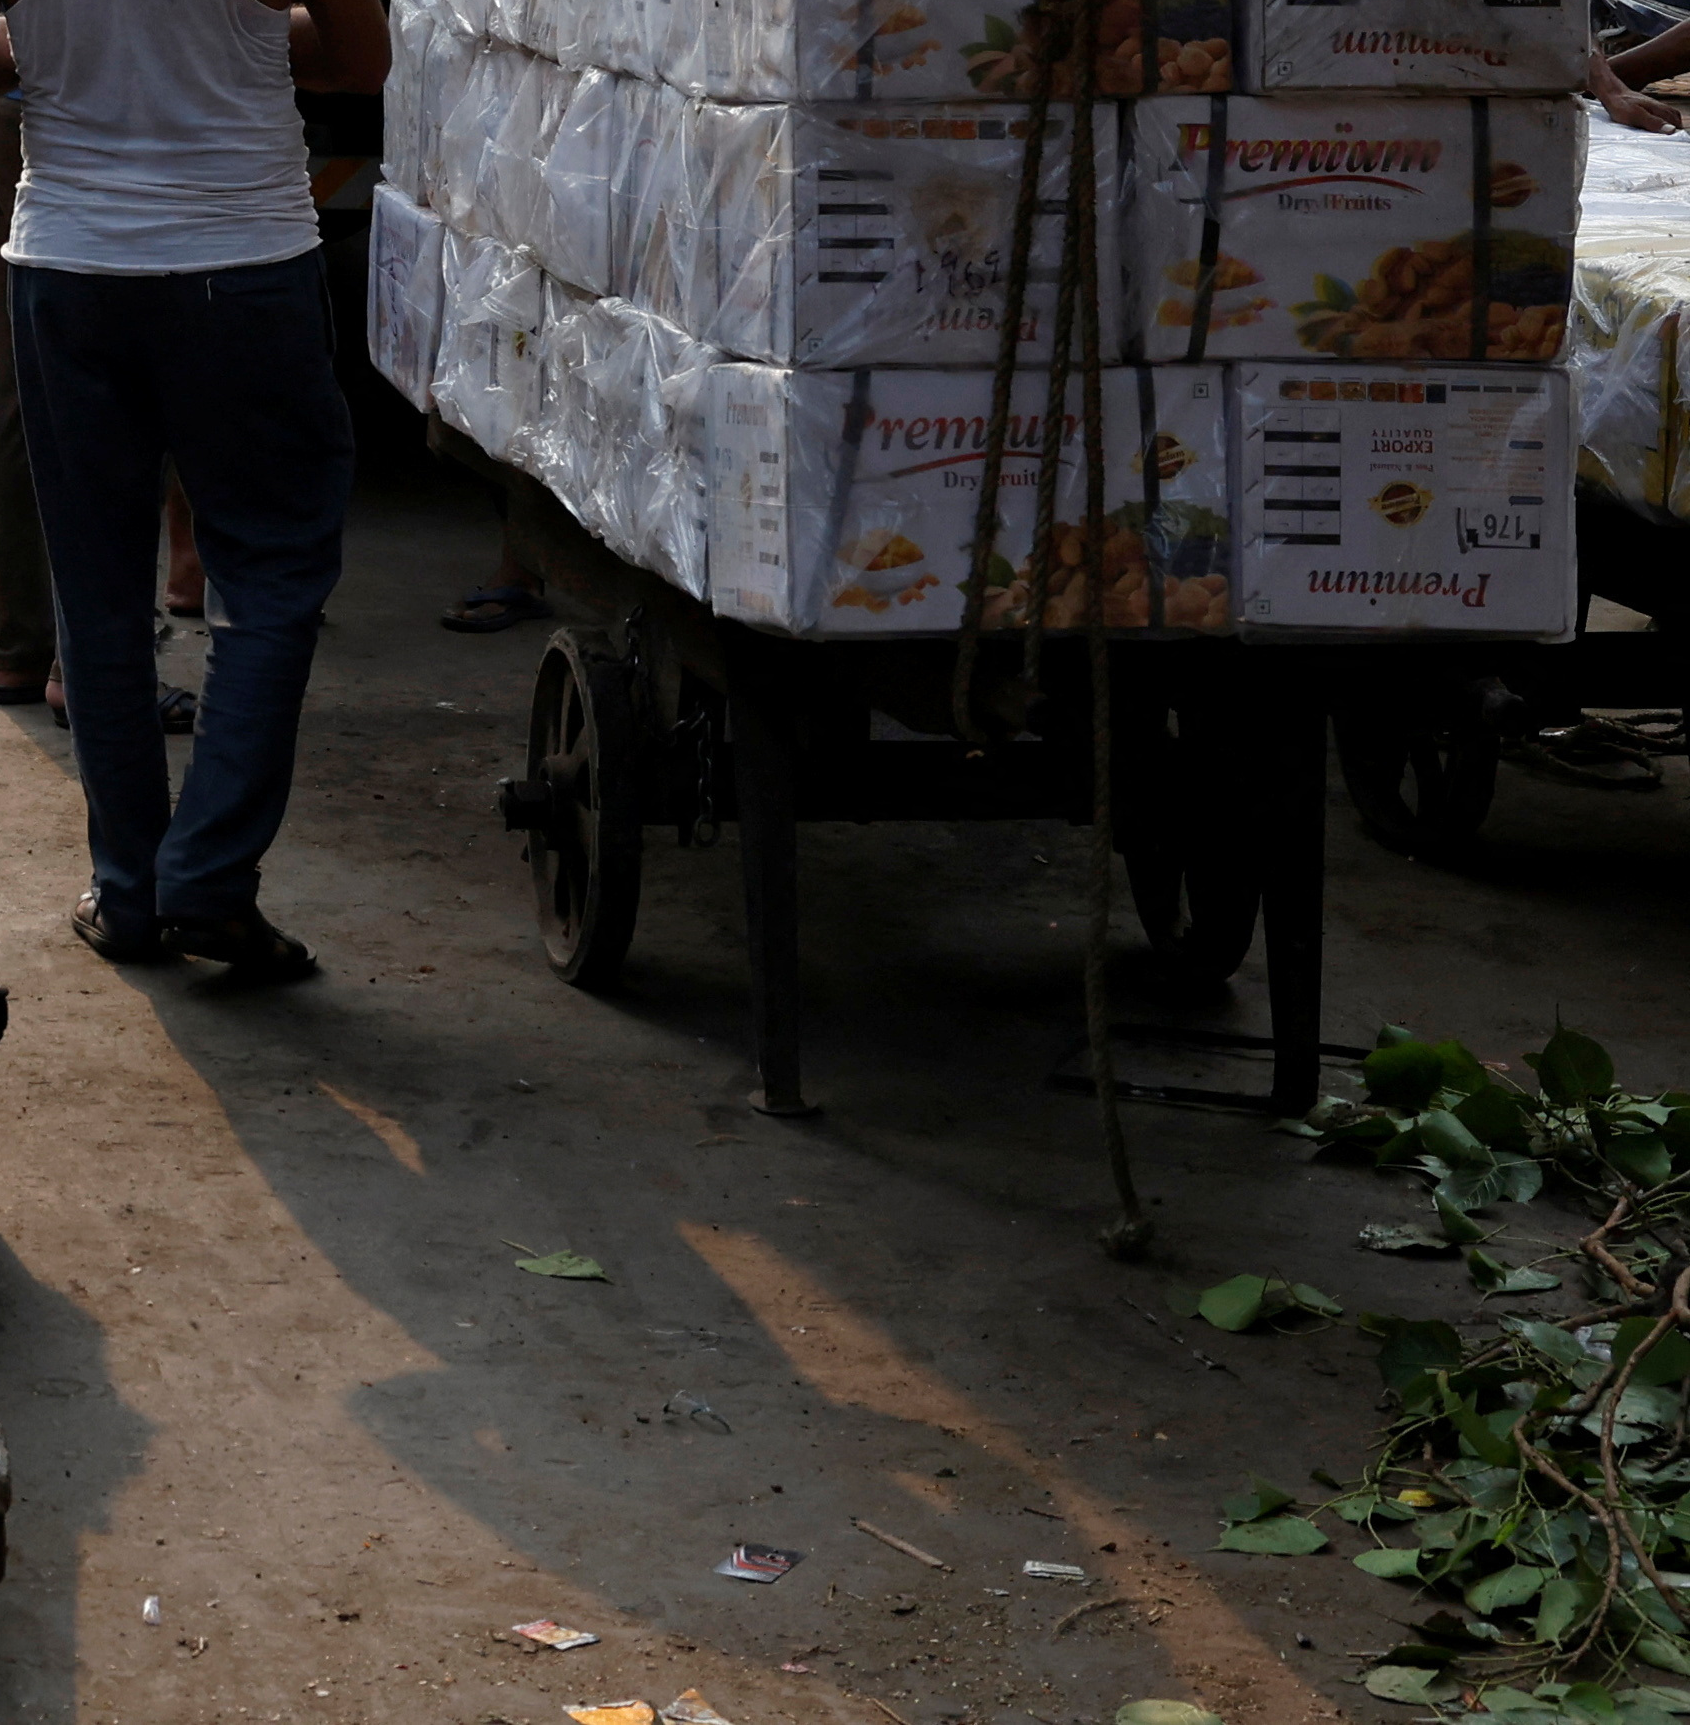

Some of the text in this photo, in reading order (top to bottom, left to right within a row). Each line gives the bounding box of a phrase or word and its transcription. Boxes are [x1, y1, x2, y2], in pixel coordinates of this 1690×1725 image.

[1168, 121, 1443, 174] Premium
[1278, 192, 1315, 215] Dry
[1371, 428, 1433, 440] QUALITY
[1371, 439, 1434, 454] EXPORT
[943, 471, 981, 492] Dry
[1482, 513, 1526, 541] 176
[1308, 569, 1492, 608] Premium
